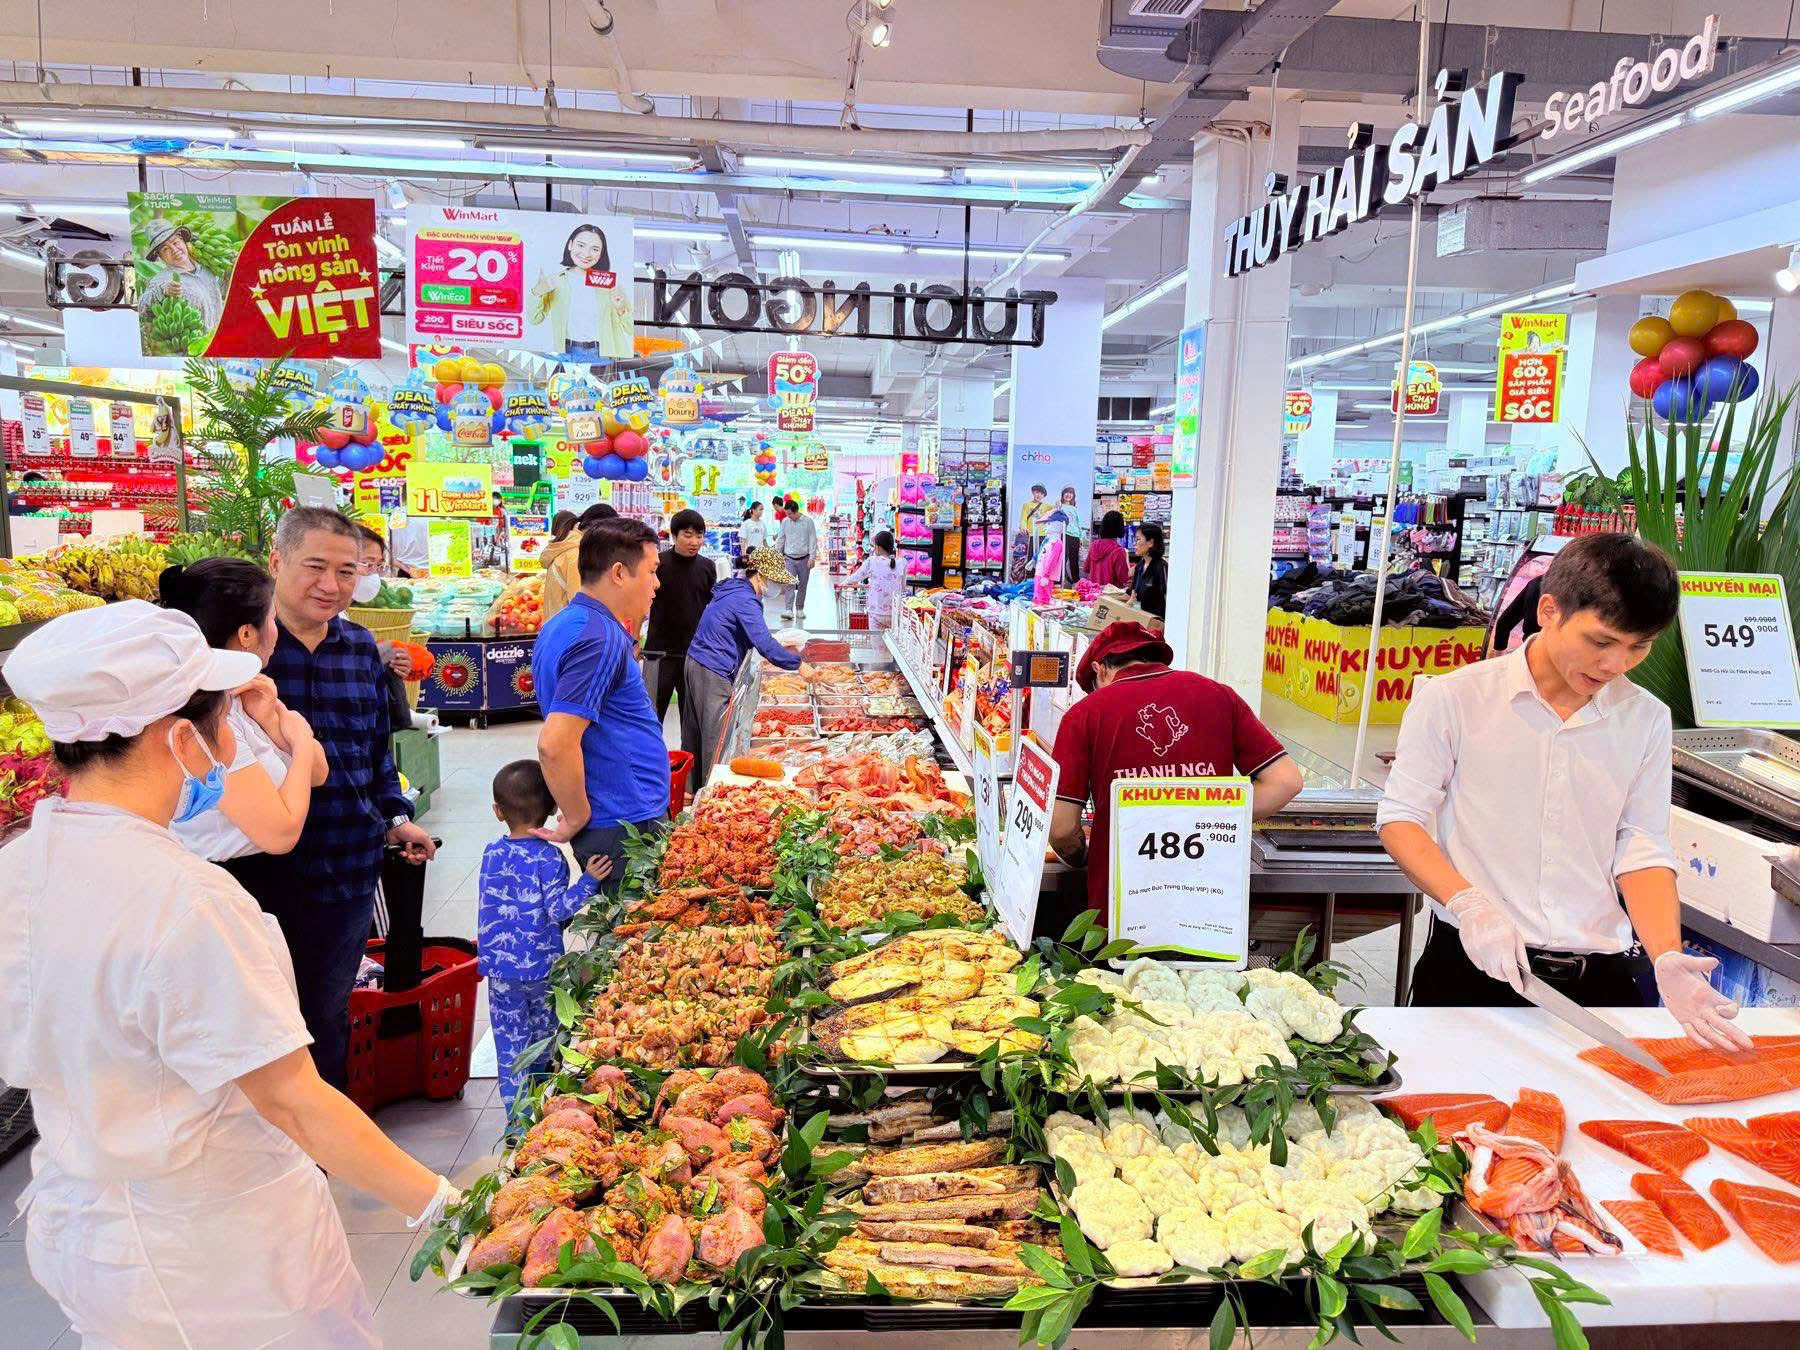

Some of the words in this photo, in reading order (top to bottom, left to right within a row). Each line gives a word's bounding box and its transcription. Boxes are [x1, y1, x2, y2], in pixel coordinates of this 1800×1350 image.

[1541, 14, 1720, 141] Seafood
[1304, 122, 1380, 242] HẢI
[1384, 68, 1516, 202] SẢN
[442, 208, 499, 222] WinMart
[263, 240, 303, 260] Tôn
[305, 234, 350, 256] vinh
[259, 262, 317, 284] nông
[320, 252, 360, 277] sản
[256, 280, 375, 343] VIỆT
[456, 318, 485, 329] SIÊU
[487, 318, 514, 331] SỐC
[1511, 316, 1559, 329] WinMart
[275, 367, 313, 386] DEAL
[1512, 365, 1549, 379] 600
[613, 382, 649, 399] DEAL
[1406, 382, 1436, 396] EAL
[394, 391, 433, 405] DEAL
[508, 395, 546, 408] DEAL
[668, 408, 695, 418] Downy
[1503, 396, 1552, 421] SỐC
[441, 499, 488, 513] WinMart
[1266, 622, 1299, 649] HUYẾN
[486, 647, 525, 660] dazzle
[1304, 639, 1341, 665] KHUY
[1113, 764, 1176, 779] THANH
[1180, 762, 1217, 777] NGA
[1015, 799, 1033, 839] 299
